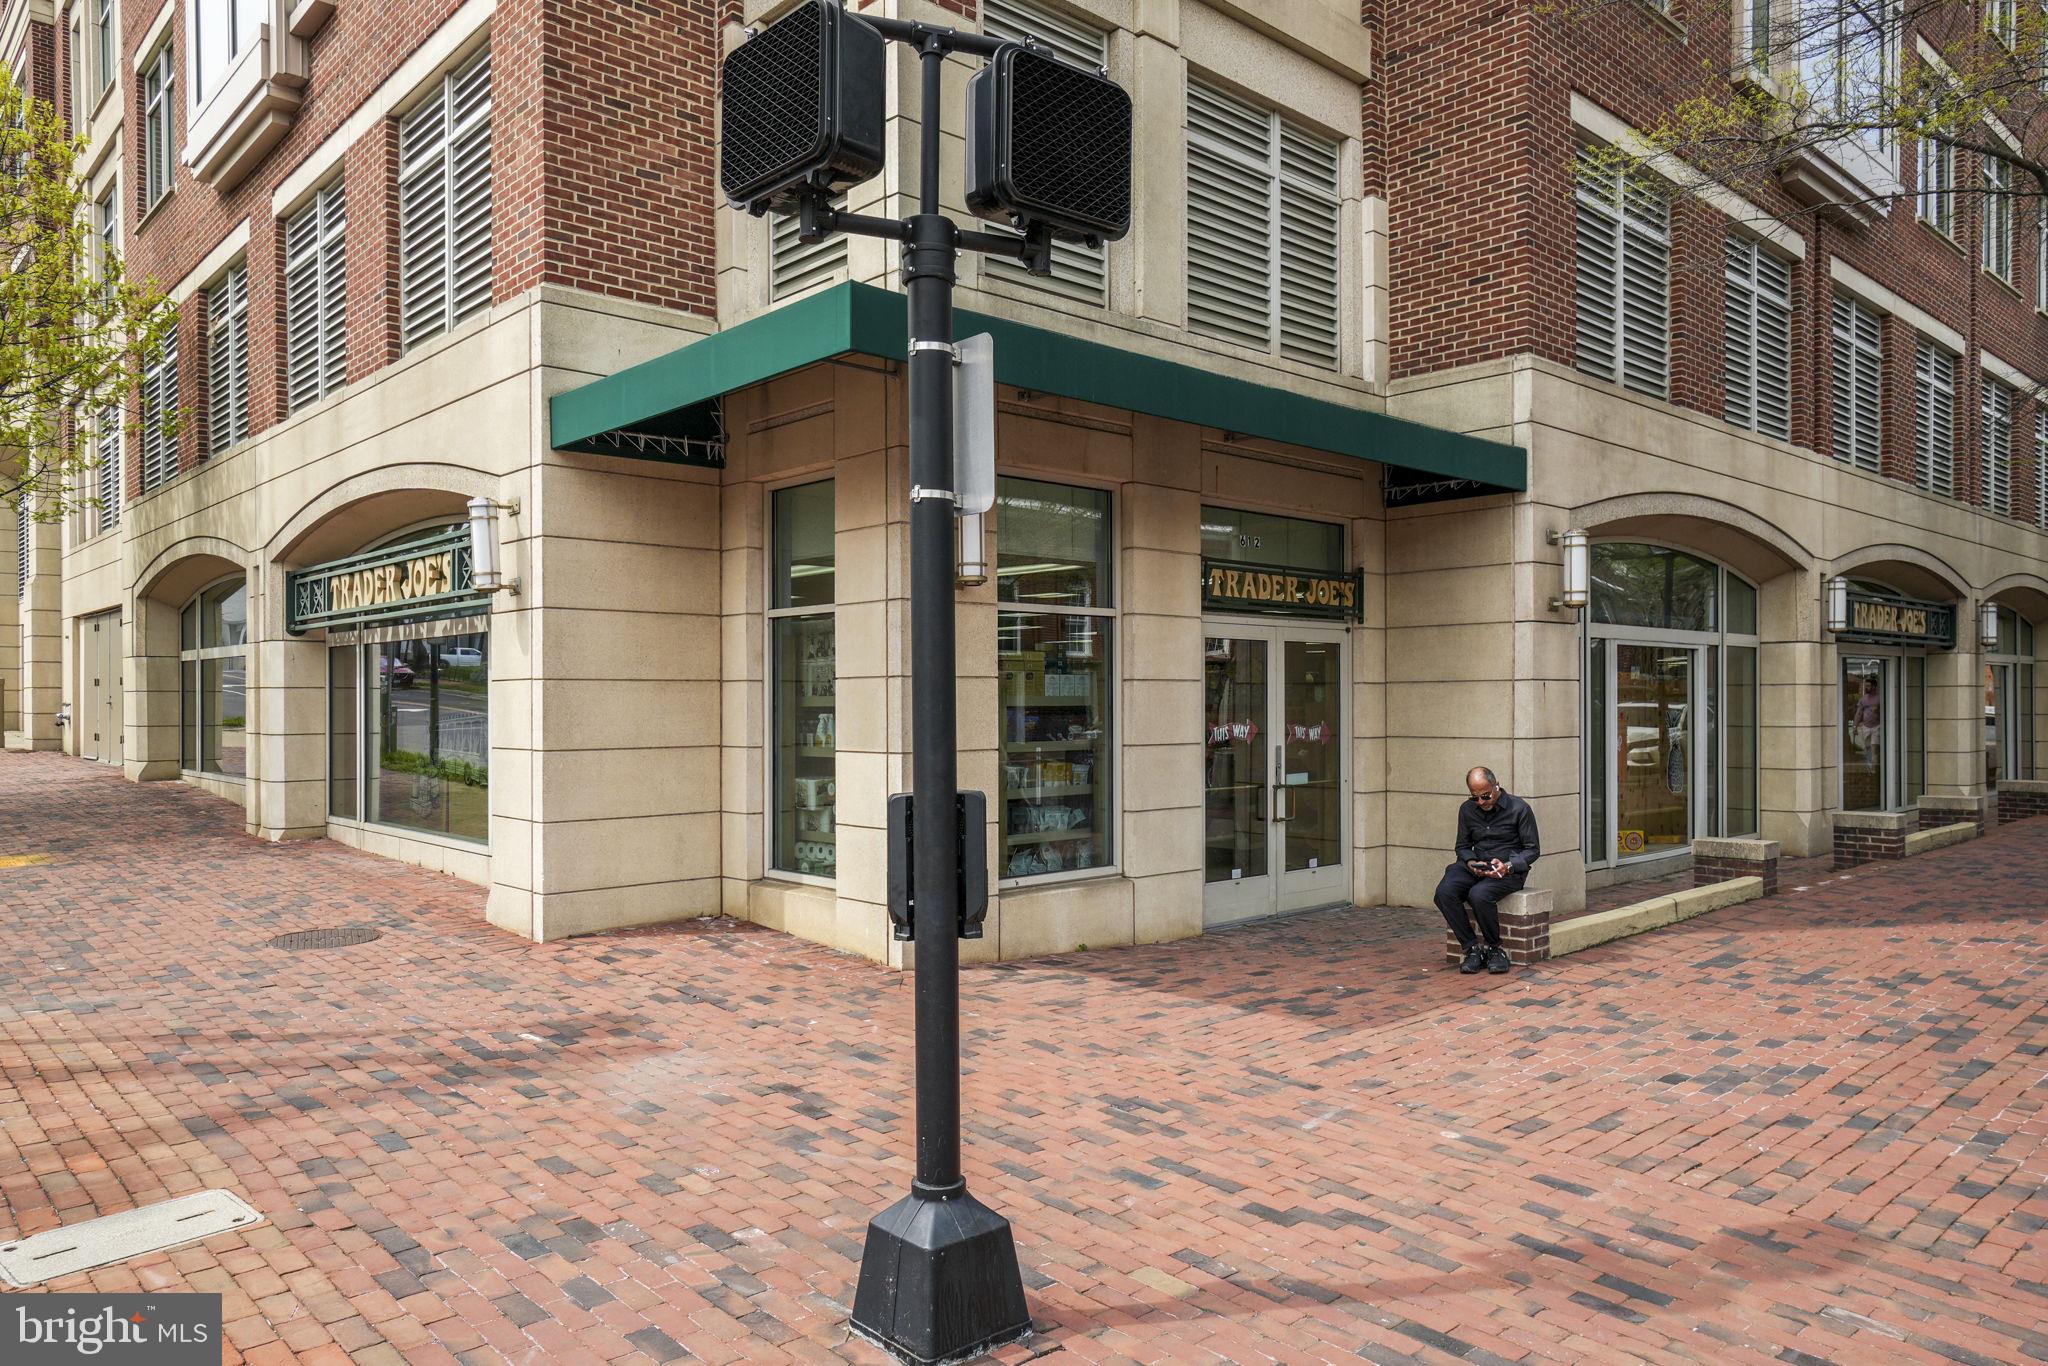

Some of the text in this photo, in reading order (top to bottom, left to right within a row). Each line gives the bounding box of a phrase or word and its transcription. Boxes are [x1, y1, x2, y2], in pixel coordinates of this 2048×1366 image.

[1240, 535, 1260, 548] 612
[330, 552, 452, 611] TRADER JOE'S
[1211, 568, 1355, 607] TRADER JOE'S
[1854, 601, 1927, 634] TRADER JOE'S
[1213, 724, 1250, 741] THIS WAY
[1294, 726, 1322, 741] THIS WAY
